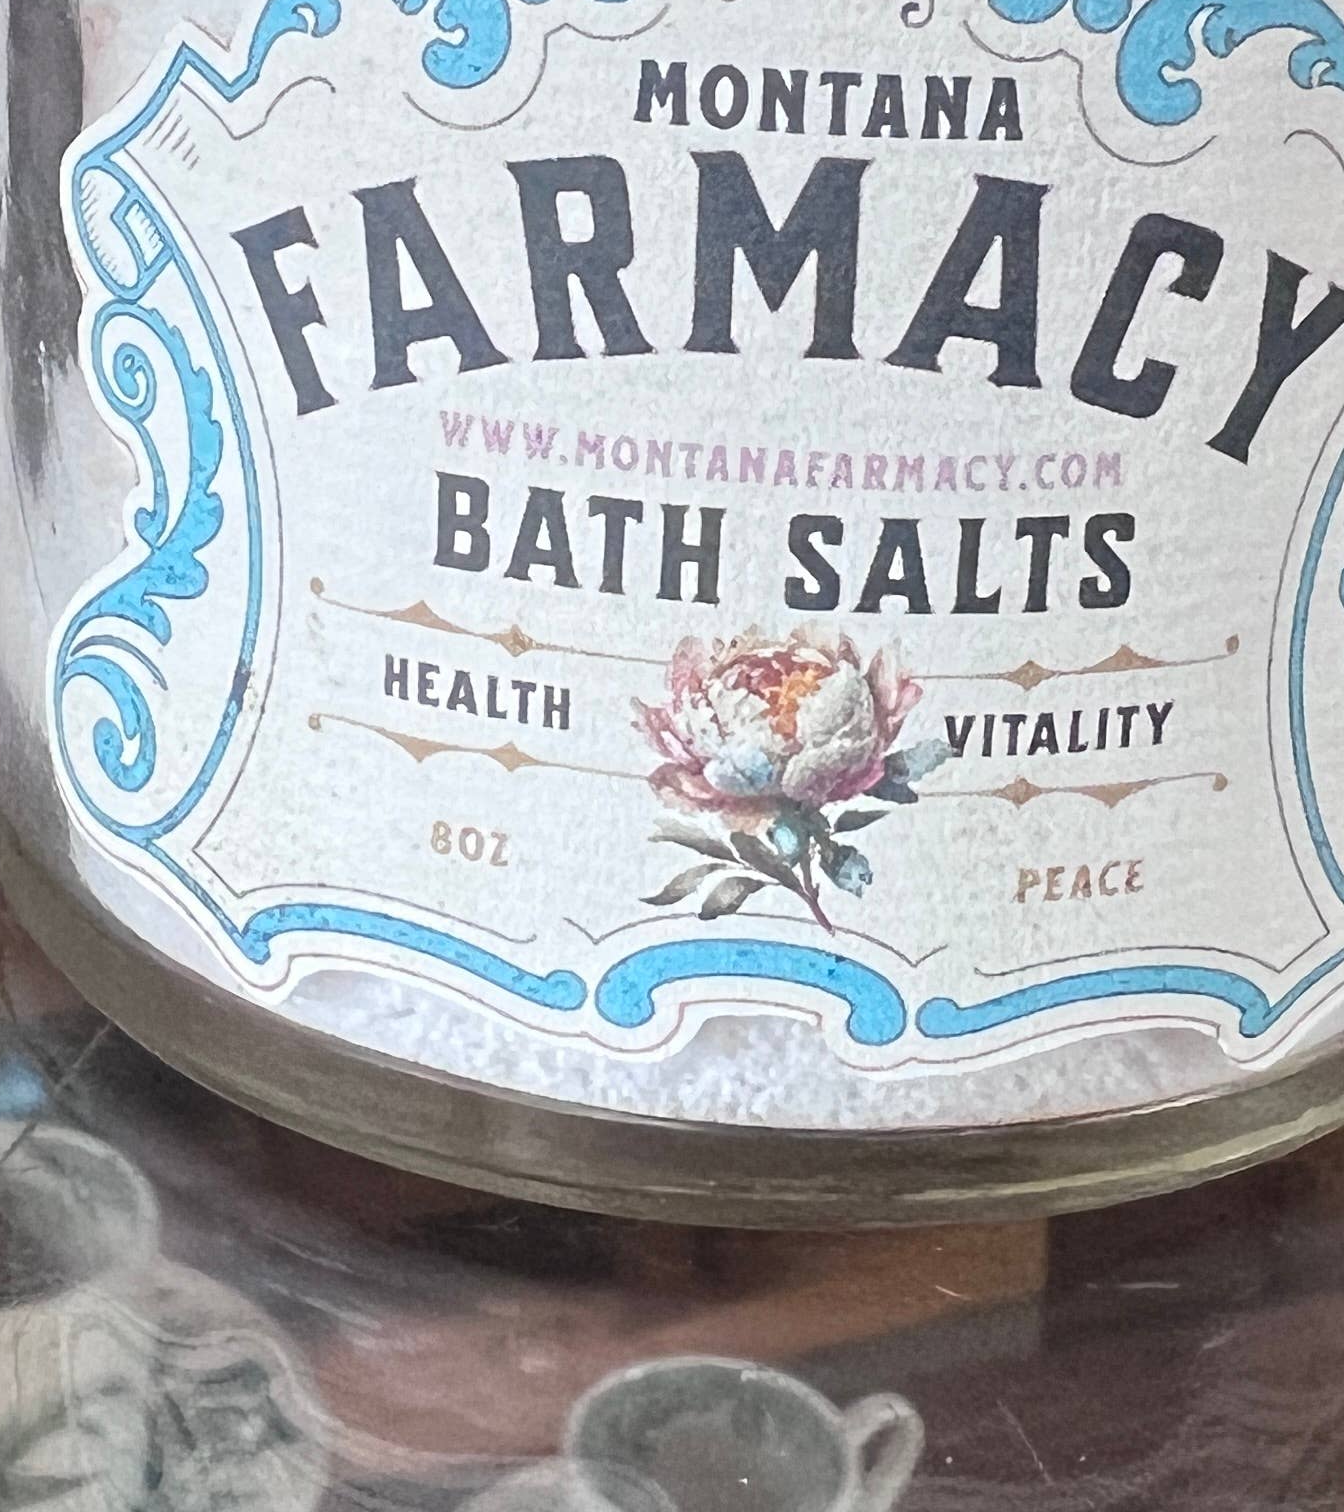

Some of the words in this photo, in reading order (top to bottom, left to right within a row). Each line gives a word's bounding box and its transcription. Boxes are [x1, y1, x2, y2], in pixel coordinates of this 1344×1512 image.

[633, 59, 1024, 142] MONTANA
[439, 410, 1124, 492] WWW.MONTANAFARMACY.COM
[433, 470, 727, 606] BATH
[784, 512, 1136, 615] SALTS
[383, 653, 570, 731] HEALTH
[944, 699, 1175, 758] VITALITY
[1012, 859, 1145, 904] PEACE
